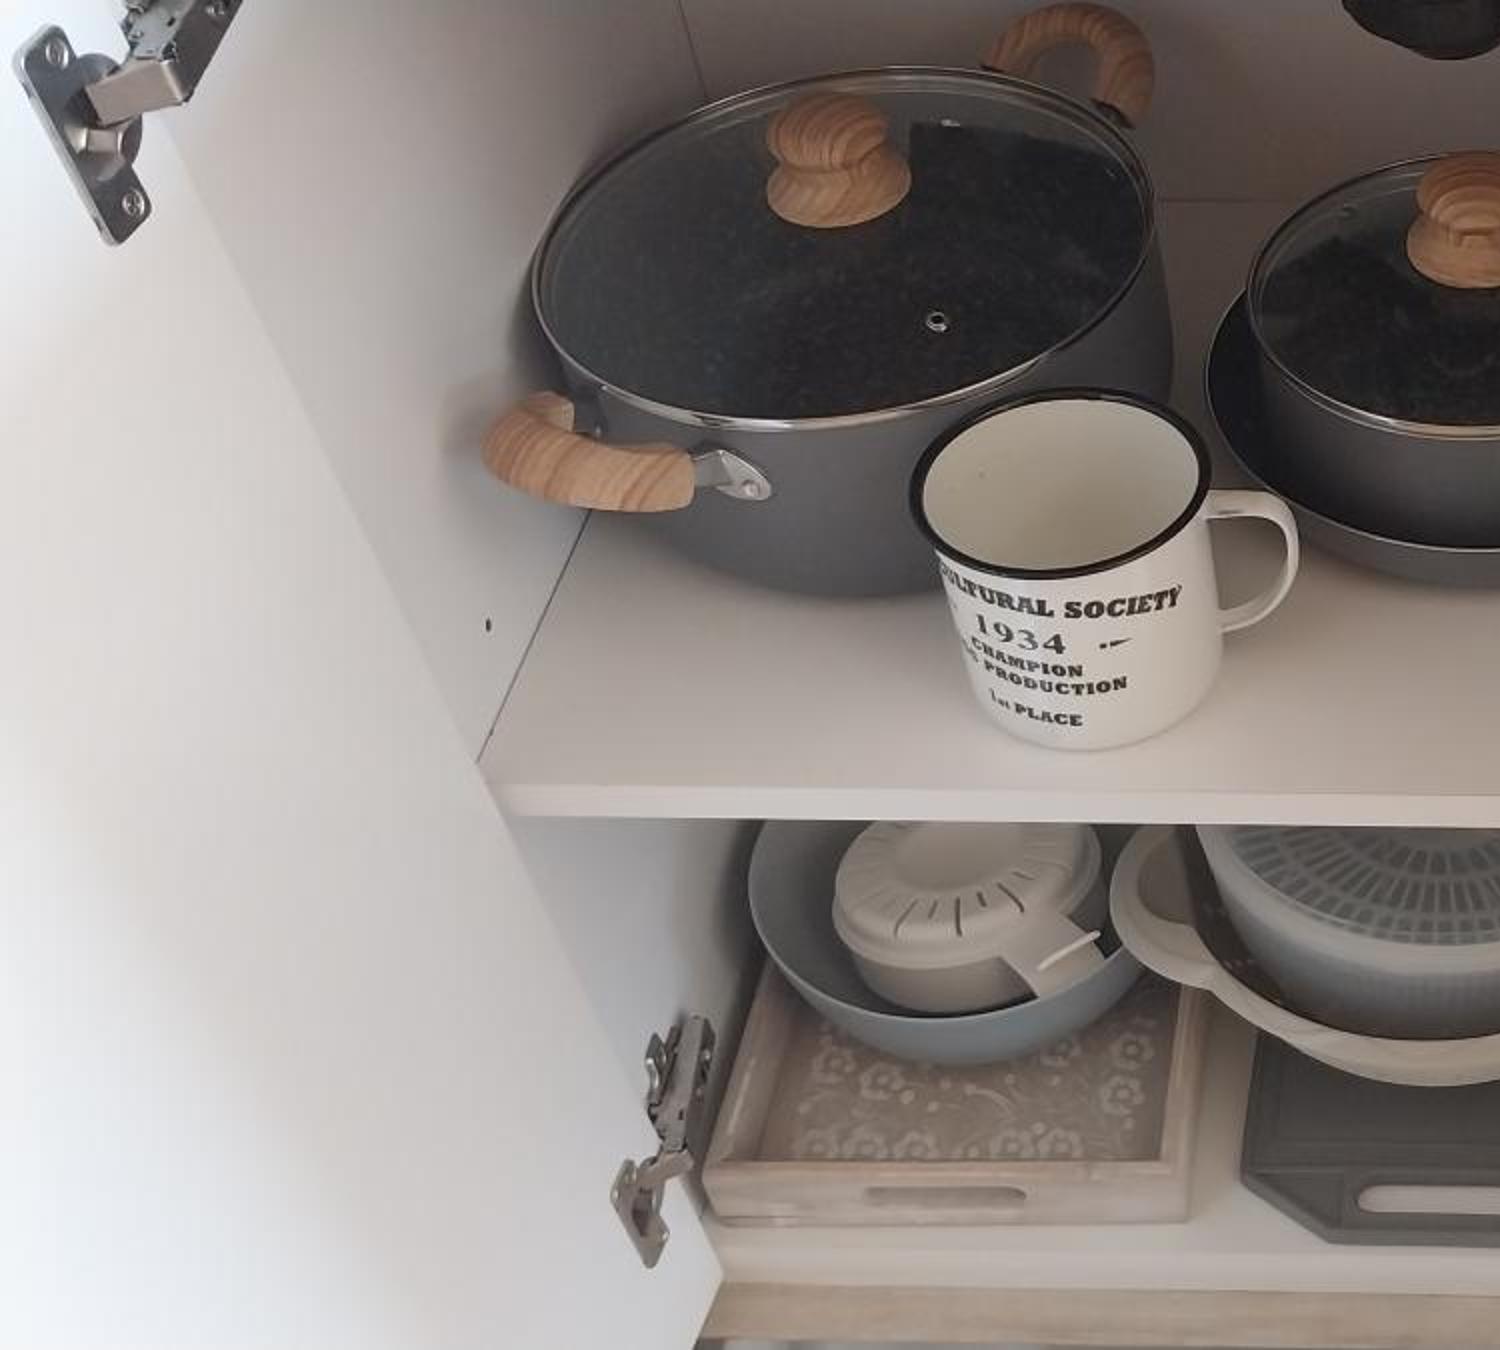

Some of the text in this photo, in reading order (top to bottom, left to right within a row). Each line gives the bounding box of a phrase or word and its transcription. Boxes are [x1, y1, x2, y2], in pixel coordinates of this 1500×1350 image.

[1063, 584, 1183, 619] SOCIETY
[976, 613, 1067, 655] 1934
[971, 636, 1084, 678] CHAMPION
[984, 659, 1128, 696] PRODUCTION
[1014, 702, 1083, 727] PLACE
